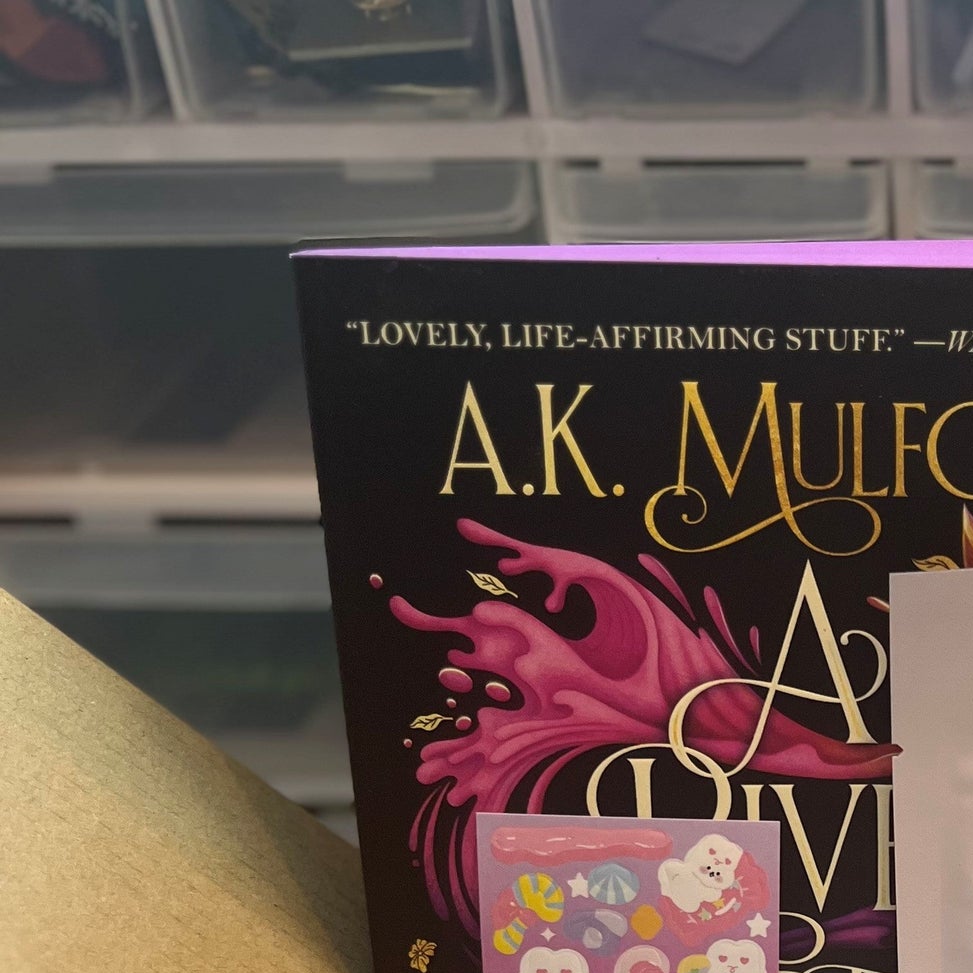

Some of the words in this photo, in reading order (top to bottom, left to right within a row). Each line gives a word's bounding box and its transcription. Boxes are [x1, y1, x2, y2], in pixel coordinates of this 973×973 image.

[346, 321, 492, 351] “LOVELY,
[502, 323, 776, 351] LIFE-AFFIRMING
[785, 328, 906, 352] STUFF.”
[440, 380, 626, 498] A.K.
[669, 558, 888, 778] A
